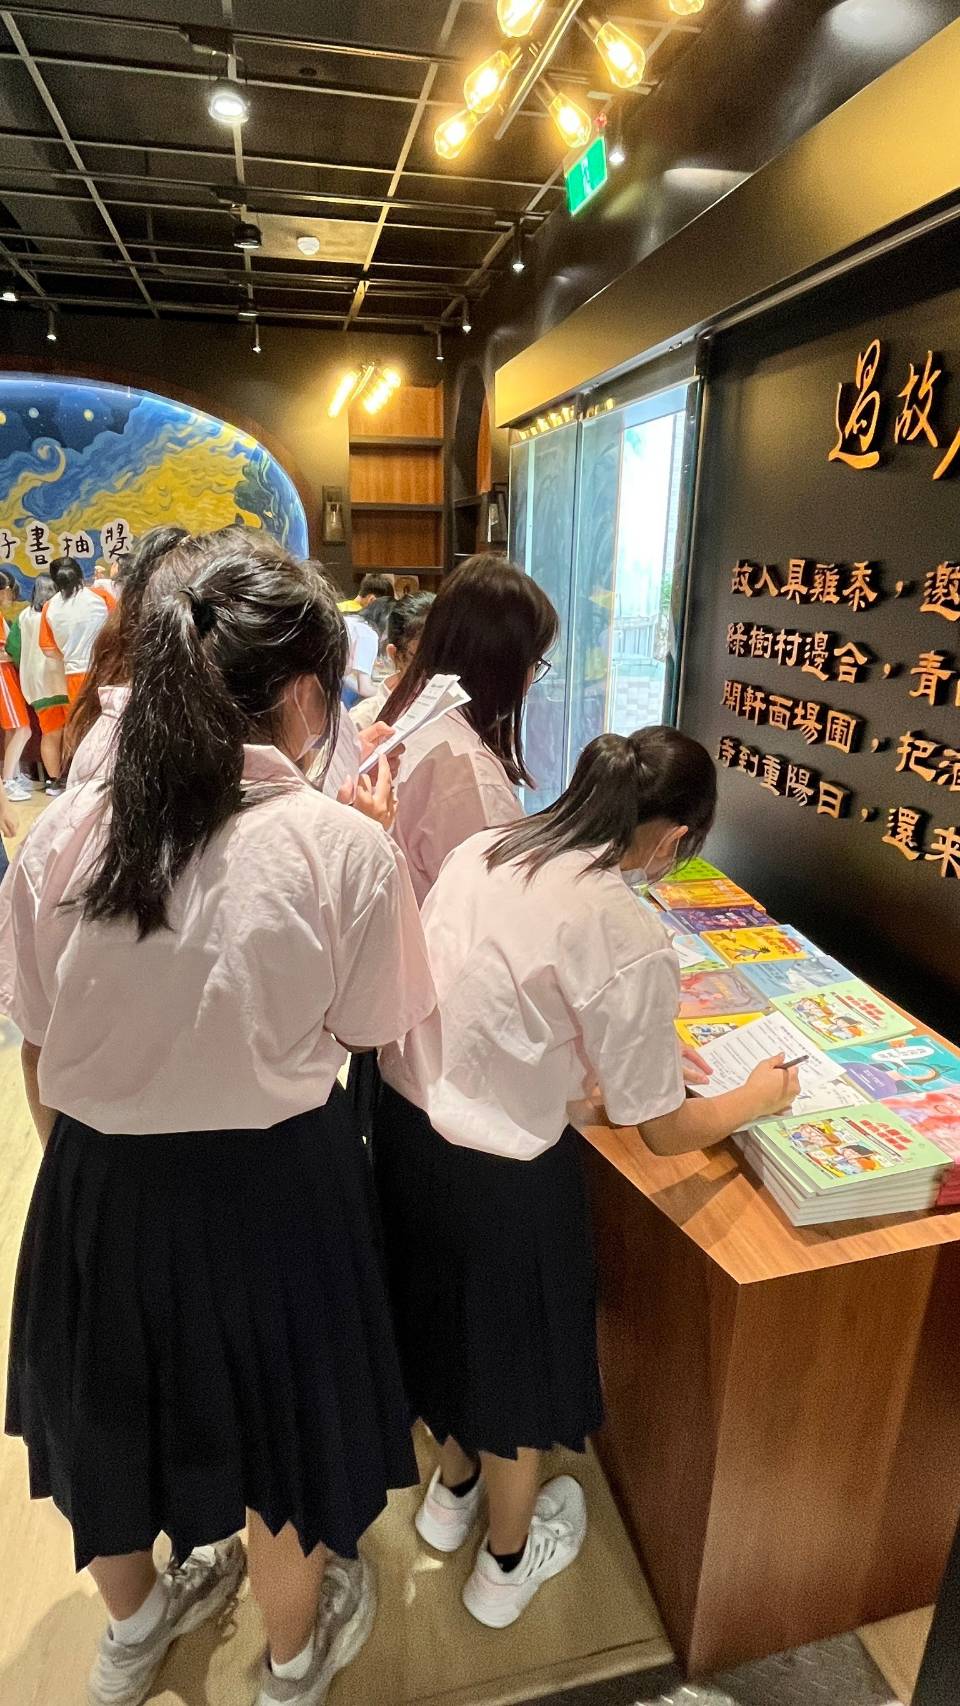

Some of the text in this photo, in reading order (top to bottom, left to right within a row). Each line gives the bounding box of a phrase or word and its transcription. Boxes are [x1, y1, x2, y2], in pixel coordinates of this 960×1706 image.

[828, 338, 960, 481] 過故
[726, 621, 960, 706] 綠樹村邊合，青
